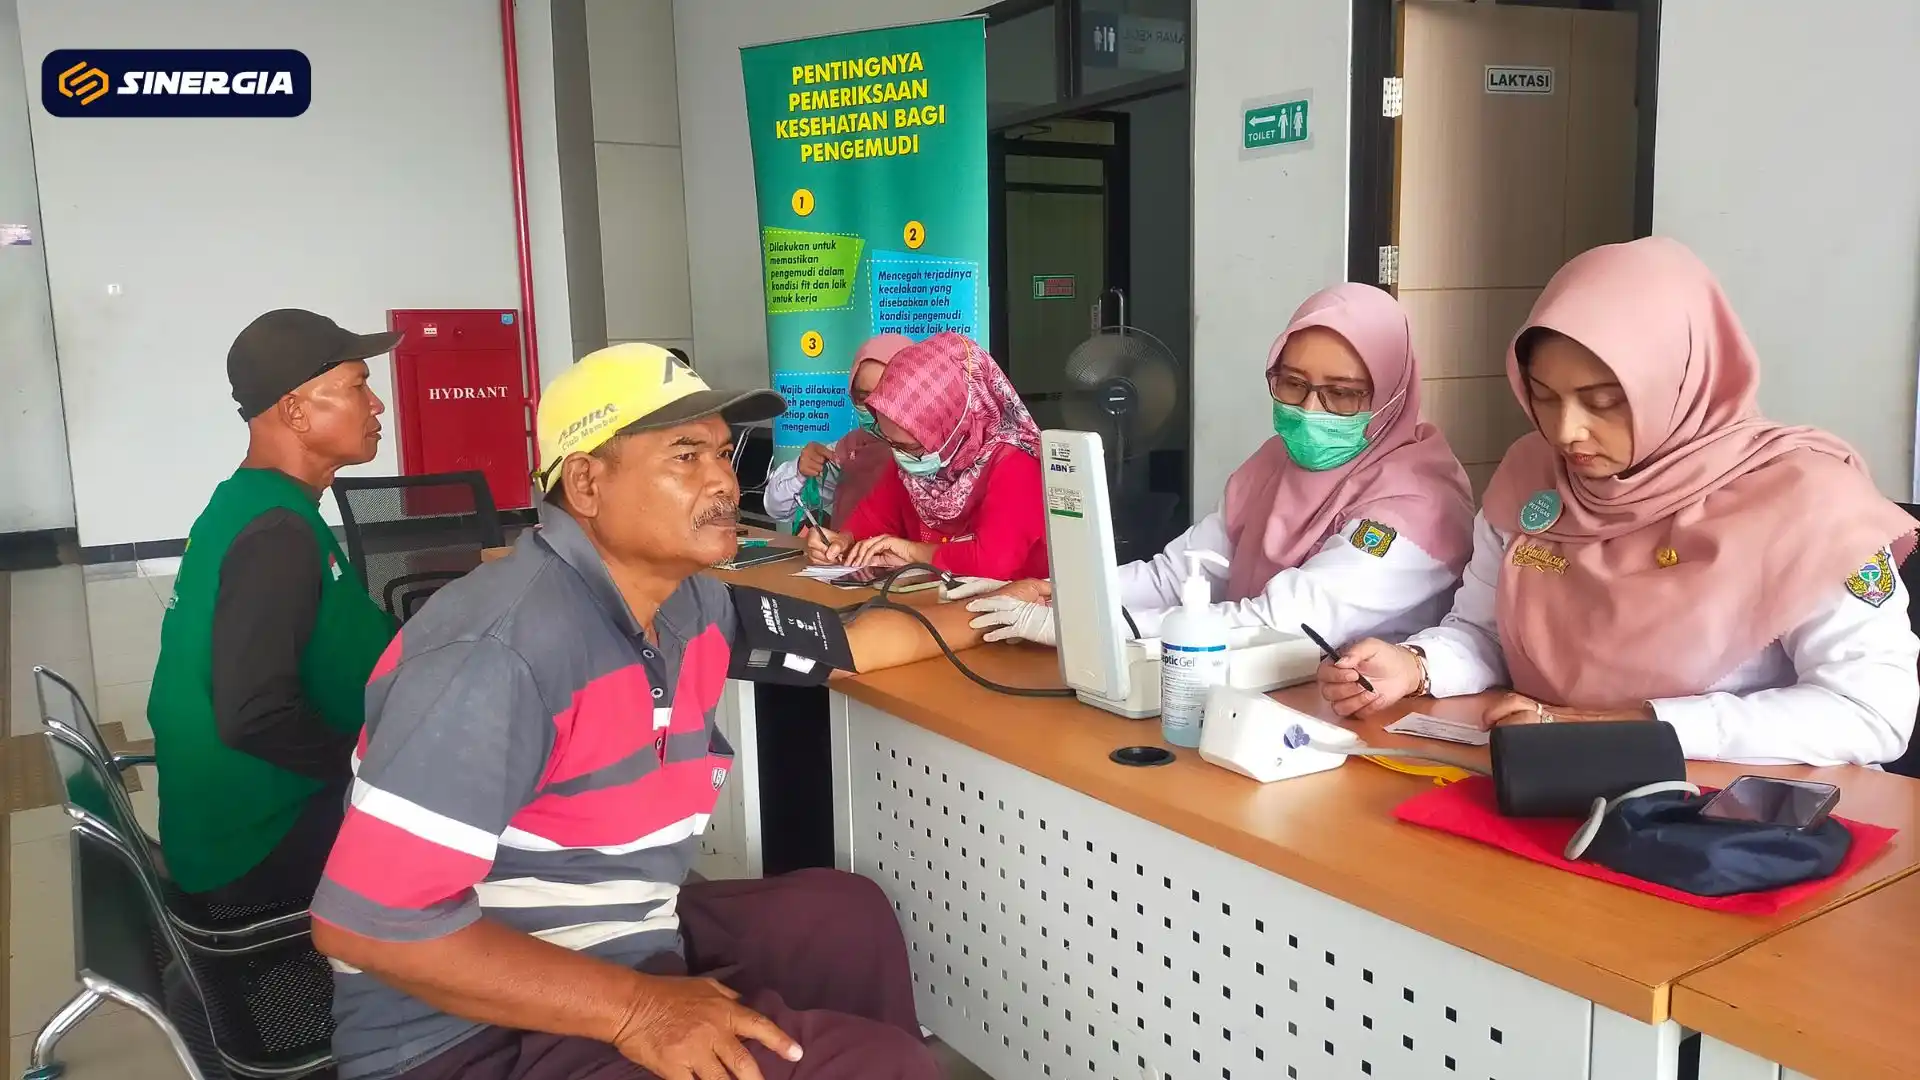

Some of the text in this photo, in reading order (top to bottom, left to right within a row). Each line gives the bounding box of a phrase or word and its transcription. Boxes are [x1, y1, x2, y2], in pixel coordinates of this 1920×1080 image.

[792, 51, 924, 86] PENTINGNYA
[1490, 73, 1549, 88] LAKTASI
[788, 78, 928, 112] PEMERIKSAAN
[775, 104, 945, 140] KESEHATAN BAGI
[1248, 129, 1276, 142] TOILET
[800, 134, 919, 163] PENGEMUDI
[799, 196, 804, 209] 1
[909, 228, 917, 241] 2
[769, 239, 837, 252] Dilakukan untuk
[770, 253, 819, 265] memastikan
[770, 265, 845, 280] pengemudi dalam
[878, 267, 972, 282] Mencegah terjadinya
[771, 278, 847, 291] kondisi fit dan laik
[878, 283, 952, 296] kecelakaan yang
[772, 292, 818, 305] untuk kerja
[879, 295, 950, 308] disebabkan oleh
[879, 309, 961, 323] kondisi pengemudi
[879, 323, 971, 335] yang tidak laik kerja
[808, 337, 817, 350] 3
[428, 386, 508, 400] HYDRANT
[780, 383, 846, 397] Wajib dilakukan
[799, 396, 845, 409] pengemudi
[807, 408, 830, 420] akan
[557, 402, 619, 445] ADIRA
[781, 421, 830, 433] mengemudi
[1050, 463, 1068, 473] ABN
[762, 608, 779, 634] ABN
